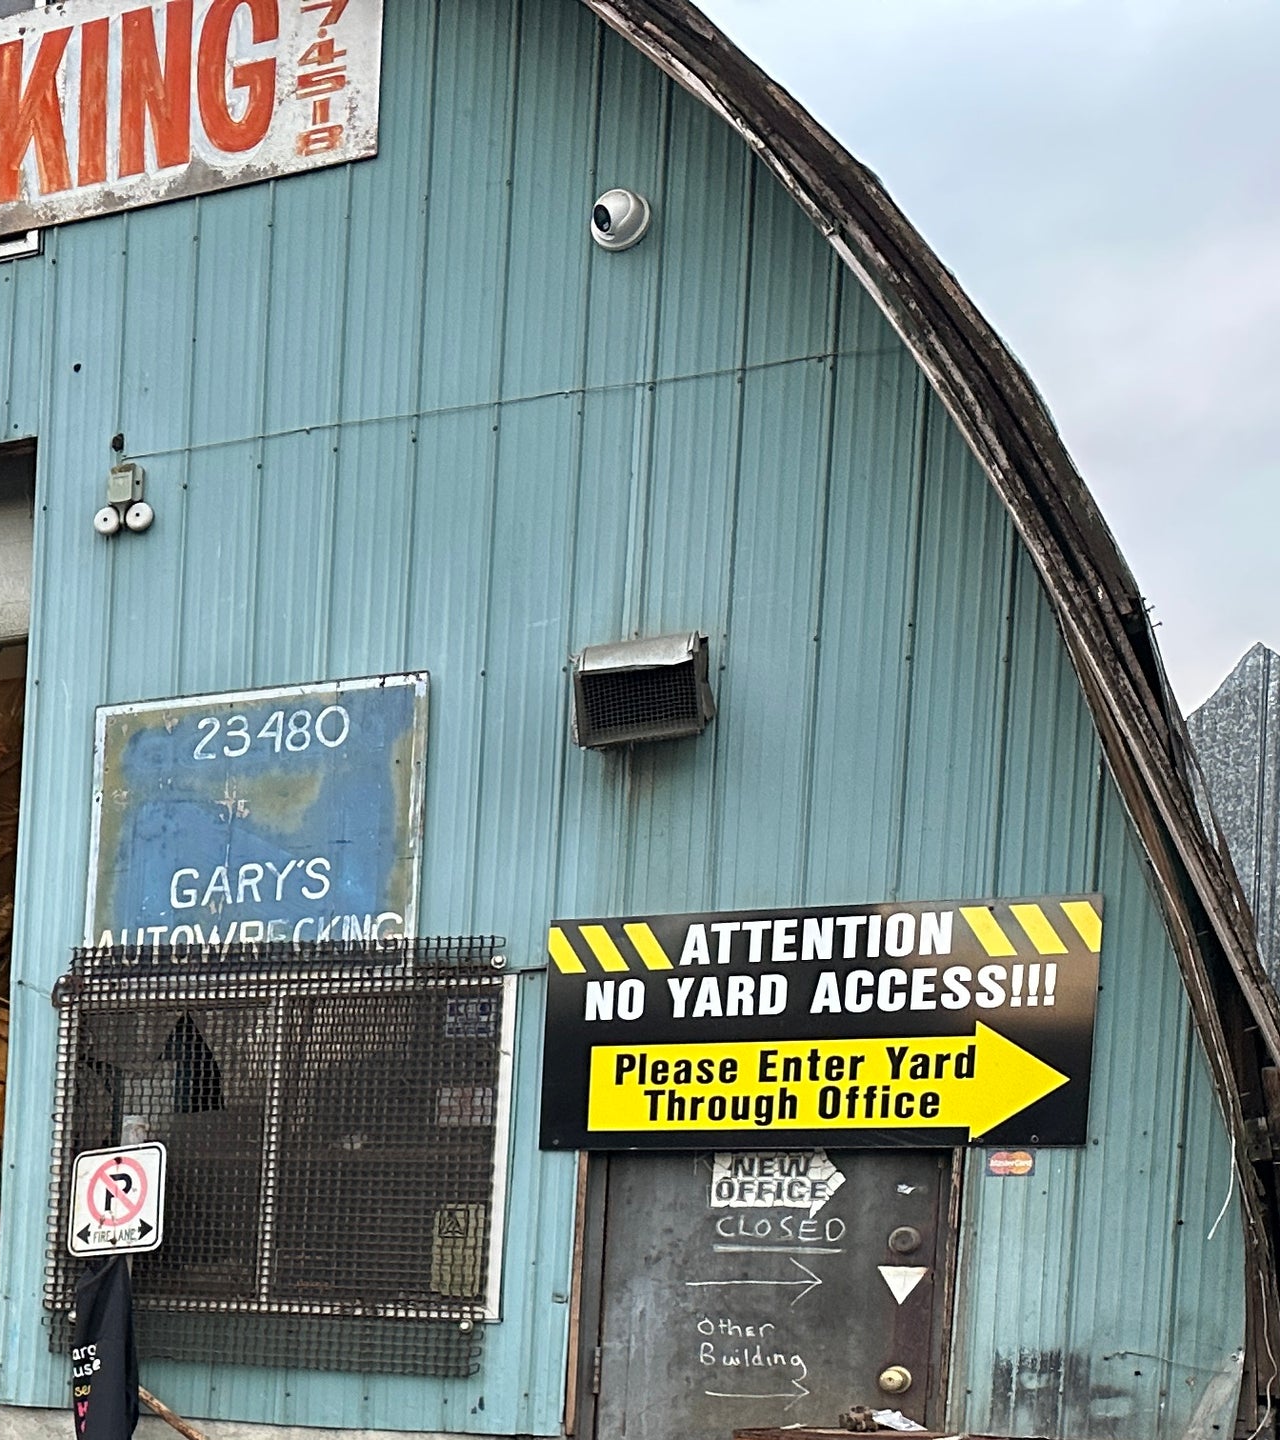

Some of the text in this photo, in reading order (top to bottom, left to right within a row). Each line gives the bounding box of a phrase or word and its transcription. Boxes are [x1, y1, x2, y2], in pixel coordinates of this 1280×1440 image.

[170, 857, 332, 910] GARY'S
[680, 911, 953, 966] ATTENTION
[585, 962, 1058, 1022] NO YARD ACCESS!!!
[615, 1044, 977, 1086] Please Enter Yard
[644, 1085, 940, 1126] Through Office
[732, 1154, 811, 1177] NEW
[715, 1177, 829, 1201] OFFICE
[715, 1215, 846, 1242] CLOSED
[697, 1317, 775, 1339] Other
[698, 1342, 808, 1382] Building
